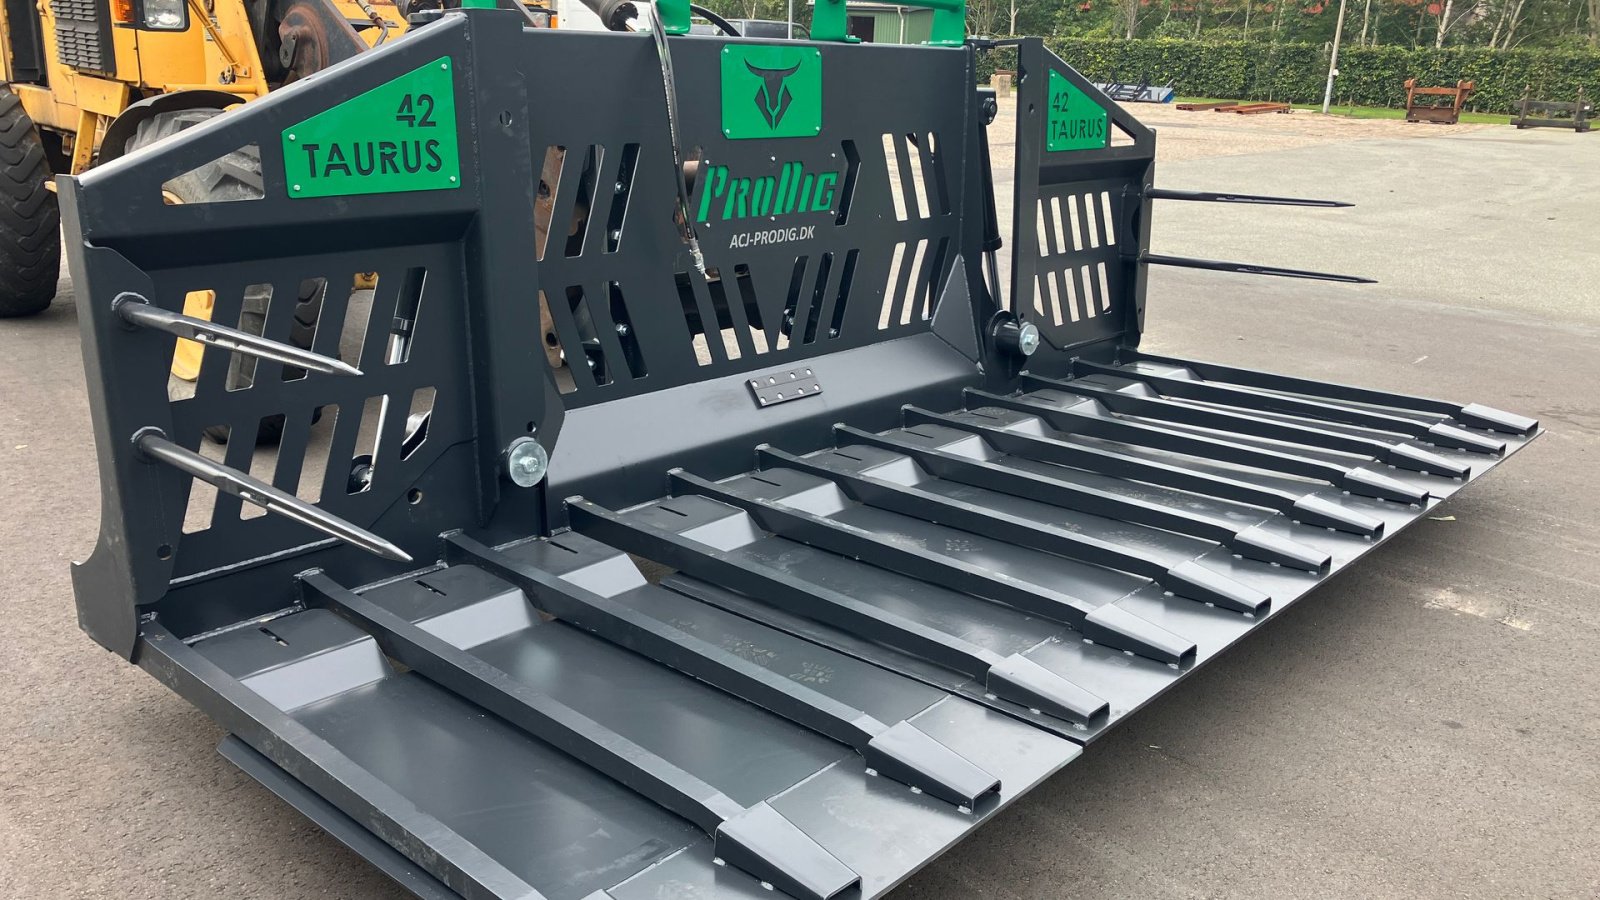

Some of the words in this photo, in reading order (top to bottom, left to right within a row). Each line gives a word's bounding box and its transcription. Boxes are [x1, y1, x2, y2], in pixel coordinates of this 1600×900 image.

[396, 93, 436, 127] 42
[1052, 91, 1069, 113] 42
[1051, 118, 1103, 140] TAURUS
[302, 139, 442, 178] TAURUS
[729, 225, 816, 248] ACJ-PRODIG.DK
